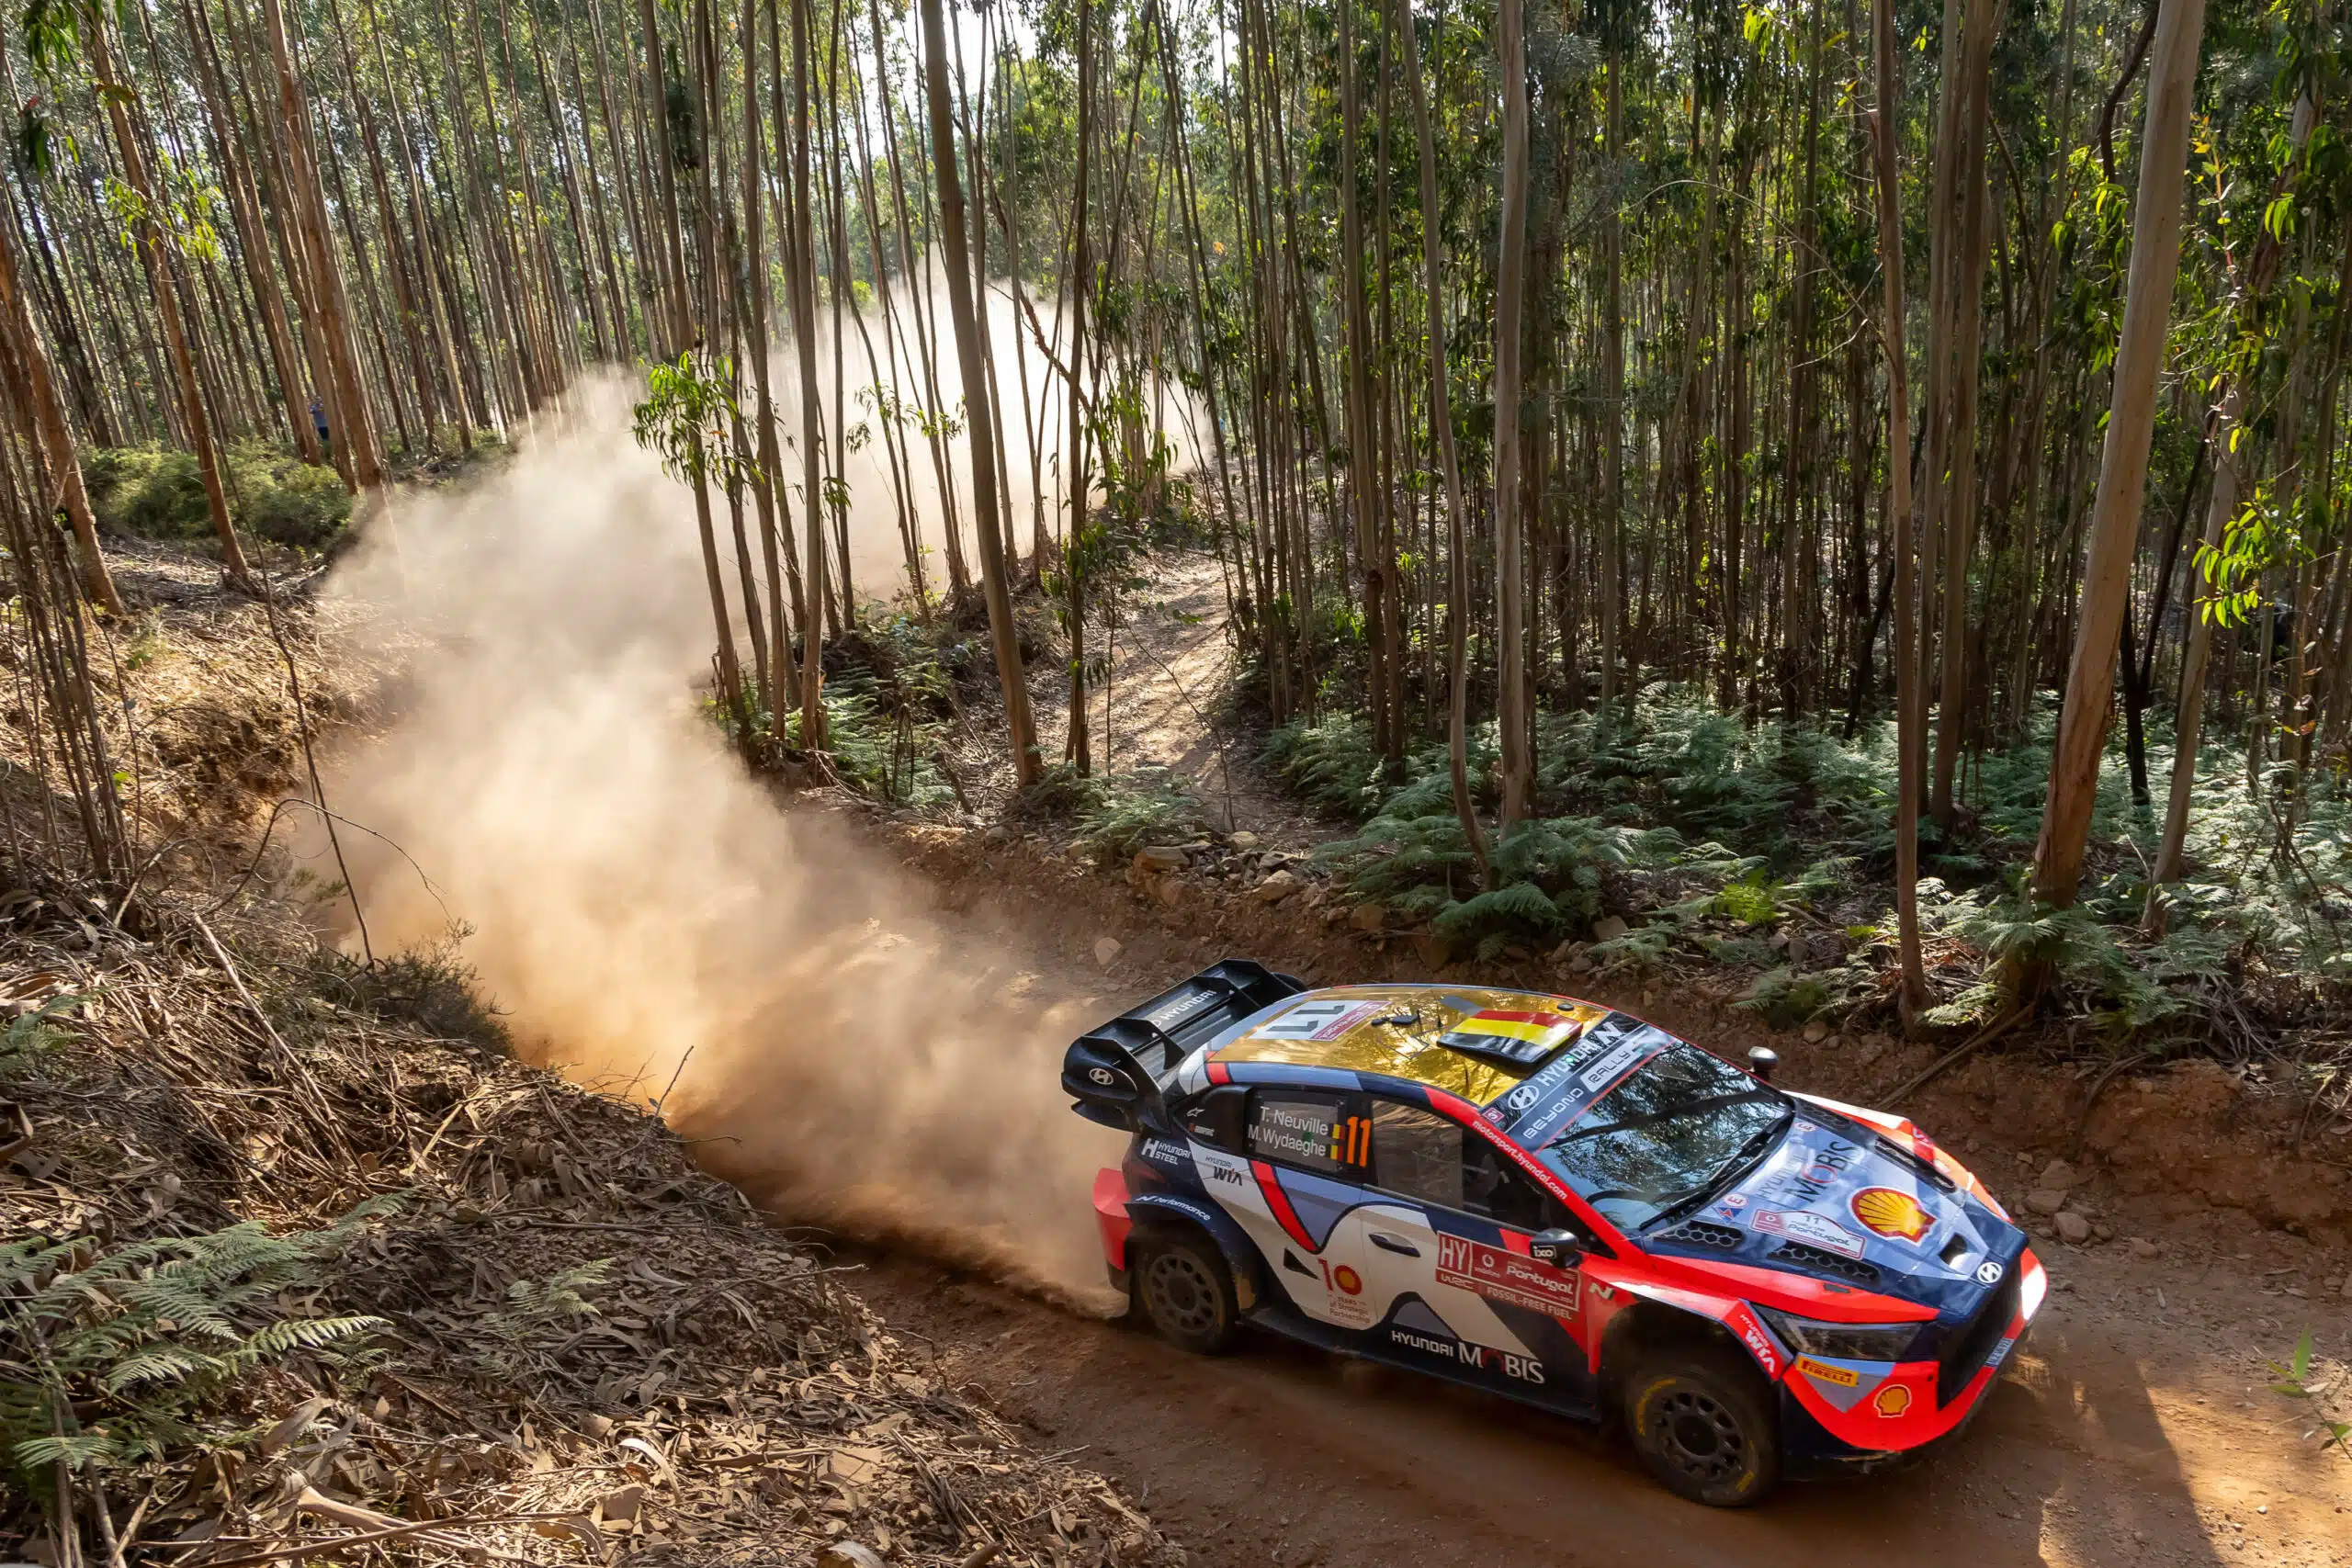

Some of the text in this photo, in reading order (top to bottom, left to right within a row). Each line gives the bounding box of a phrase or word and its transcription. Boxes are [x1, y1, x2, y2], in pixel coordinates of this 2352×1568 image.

[1160, 989, 1217, 1021] HYUNDAI
[1523, 1051, 1631, 1139] BEYOND RALLY
[1260, 1105, 1329, 1136] T. Neuville
[1158, 1140, 1191, 1159] HYUNDAI
[1347, 1116, 1372, 1168] 11
[1155, 1151, 1179, 1165] STEEL
[1204, 1156, 1233, 1168] HYUNDAI
[1472, 1120, 1567, 1200] motorsport.hyundai.com
[1784, 1141, 1854, 1202] MOBIS
[1214, 1168, 1242, 1186] WIA
[1804, 1215, 1819, 1224] 11
[1440, 1236, 1467, 1270] HY
[1532, 1246, 1554, 1258] ixo
[1441, 1273, 1474, 1290] WRC
[1506, 1265, 1573, 1295] Portugal
[1589, 1282, 1614, 1300] N
[1487, 1286, 1546, 1313] FOSSIL-FREE
[1547, 1304, 1572, 1320] FUEL
[1392, 1330, 1453, 1358] HYUNDAI
[1803, 1359, 1853, 1383] PIRELLI
